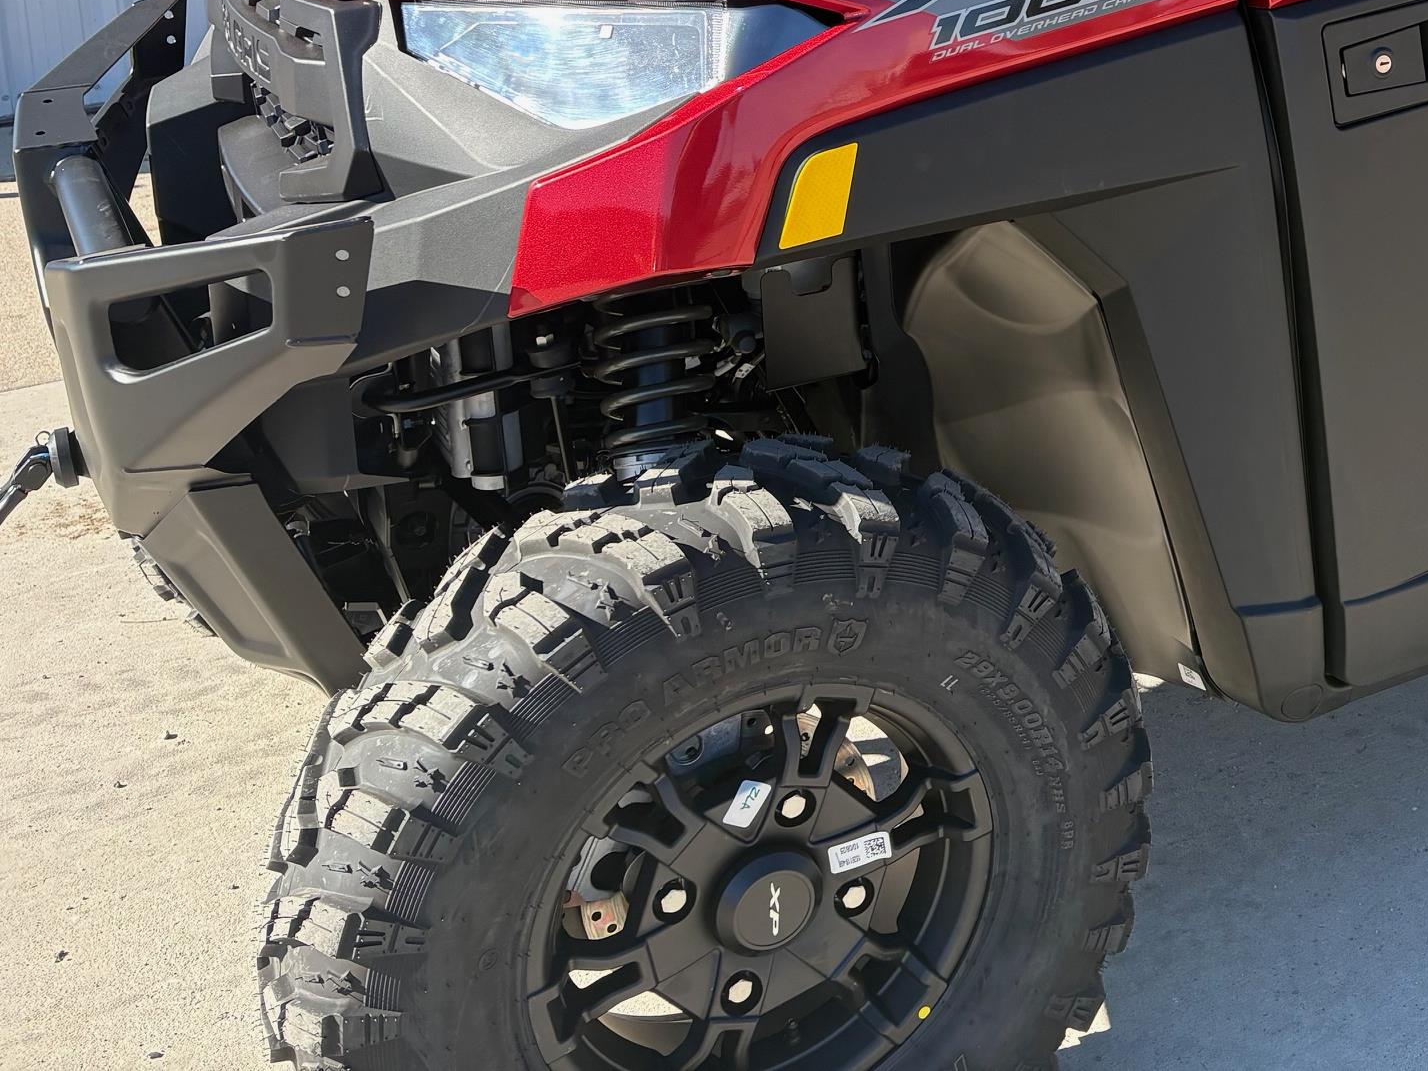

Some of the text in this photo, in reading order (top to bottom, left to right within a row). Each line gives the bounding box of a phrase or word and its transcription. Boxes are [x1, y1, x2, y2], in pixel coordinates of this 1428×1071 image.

[930, 39, 985, 63] DUAL
[990, 6, 1096, 43] OVERHEAD
[663, 625, 823, 708] ARMOR
[769, 882, 781, 937] XP
